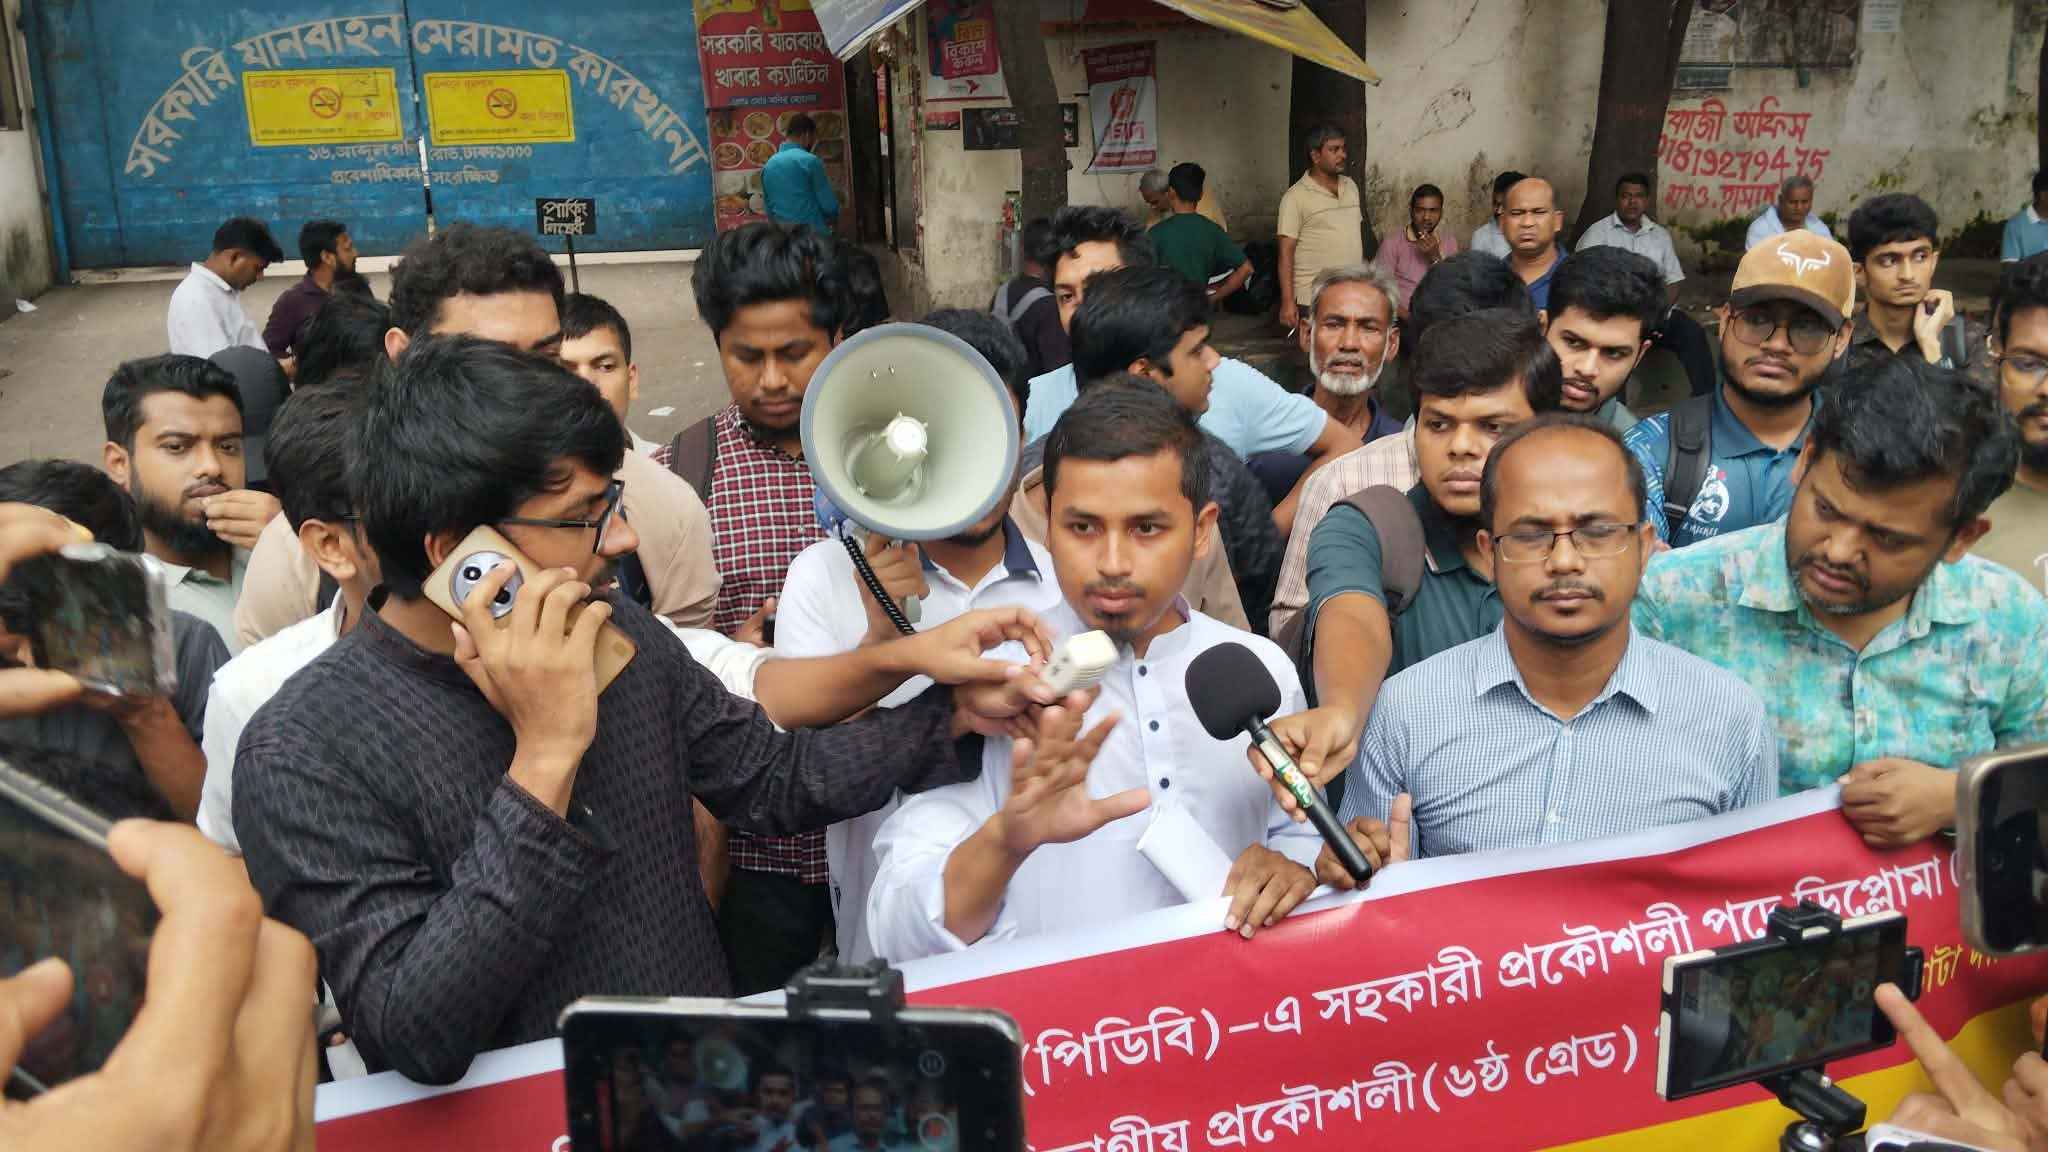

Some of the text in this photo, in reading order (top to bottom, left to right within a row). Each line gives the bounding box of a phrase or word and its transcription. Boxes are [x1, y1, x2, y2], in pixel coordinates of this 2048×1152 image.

[124, 13, 710, 178] সরকারি যানবাহন মেরামত কারখানা
[714, 58, 830, 89] খাবার ক্যান্টিন
[1668, 95, 1813, 144] কাজী অফিস
[543, 198, 589, 218] পার্কিং
[1311, 945, 1482, 1024] সহকারী
[1498, 902, 1694, 989] প্রকৌশলী
[1524, 1023, 1639, 1086] গ্রেড)
